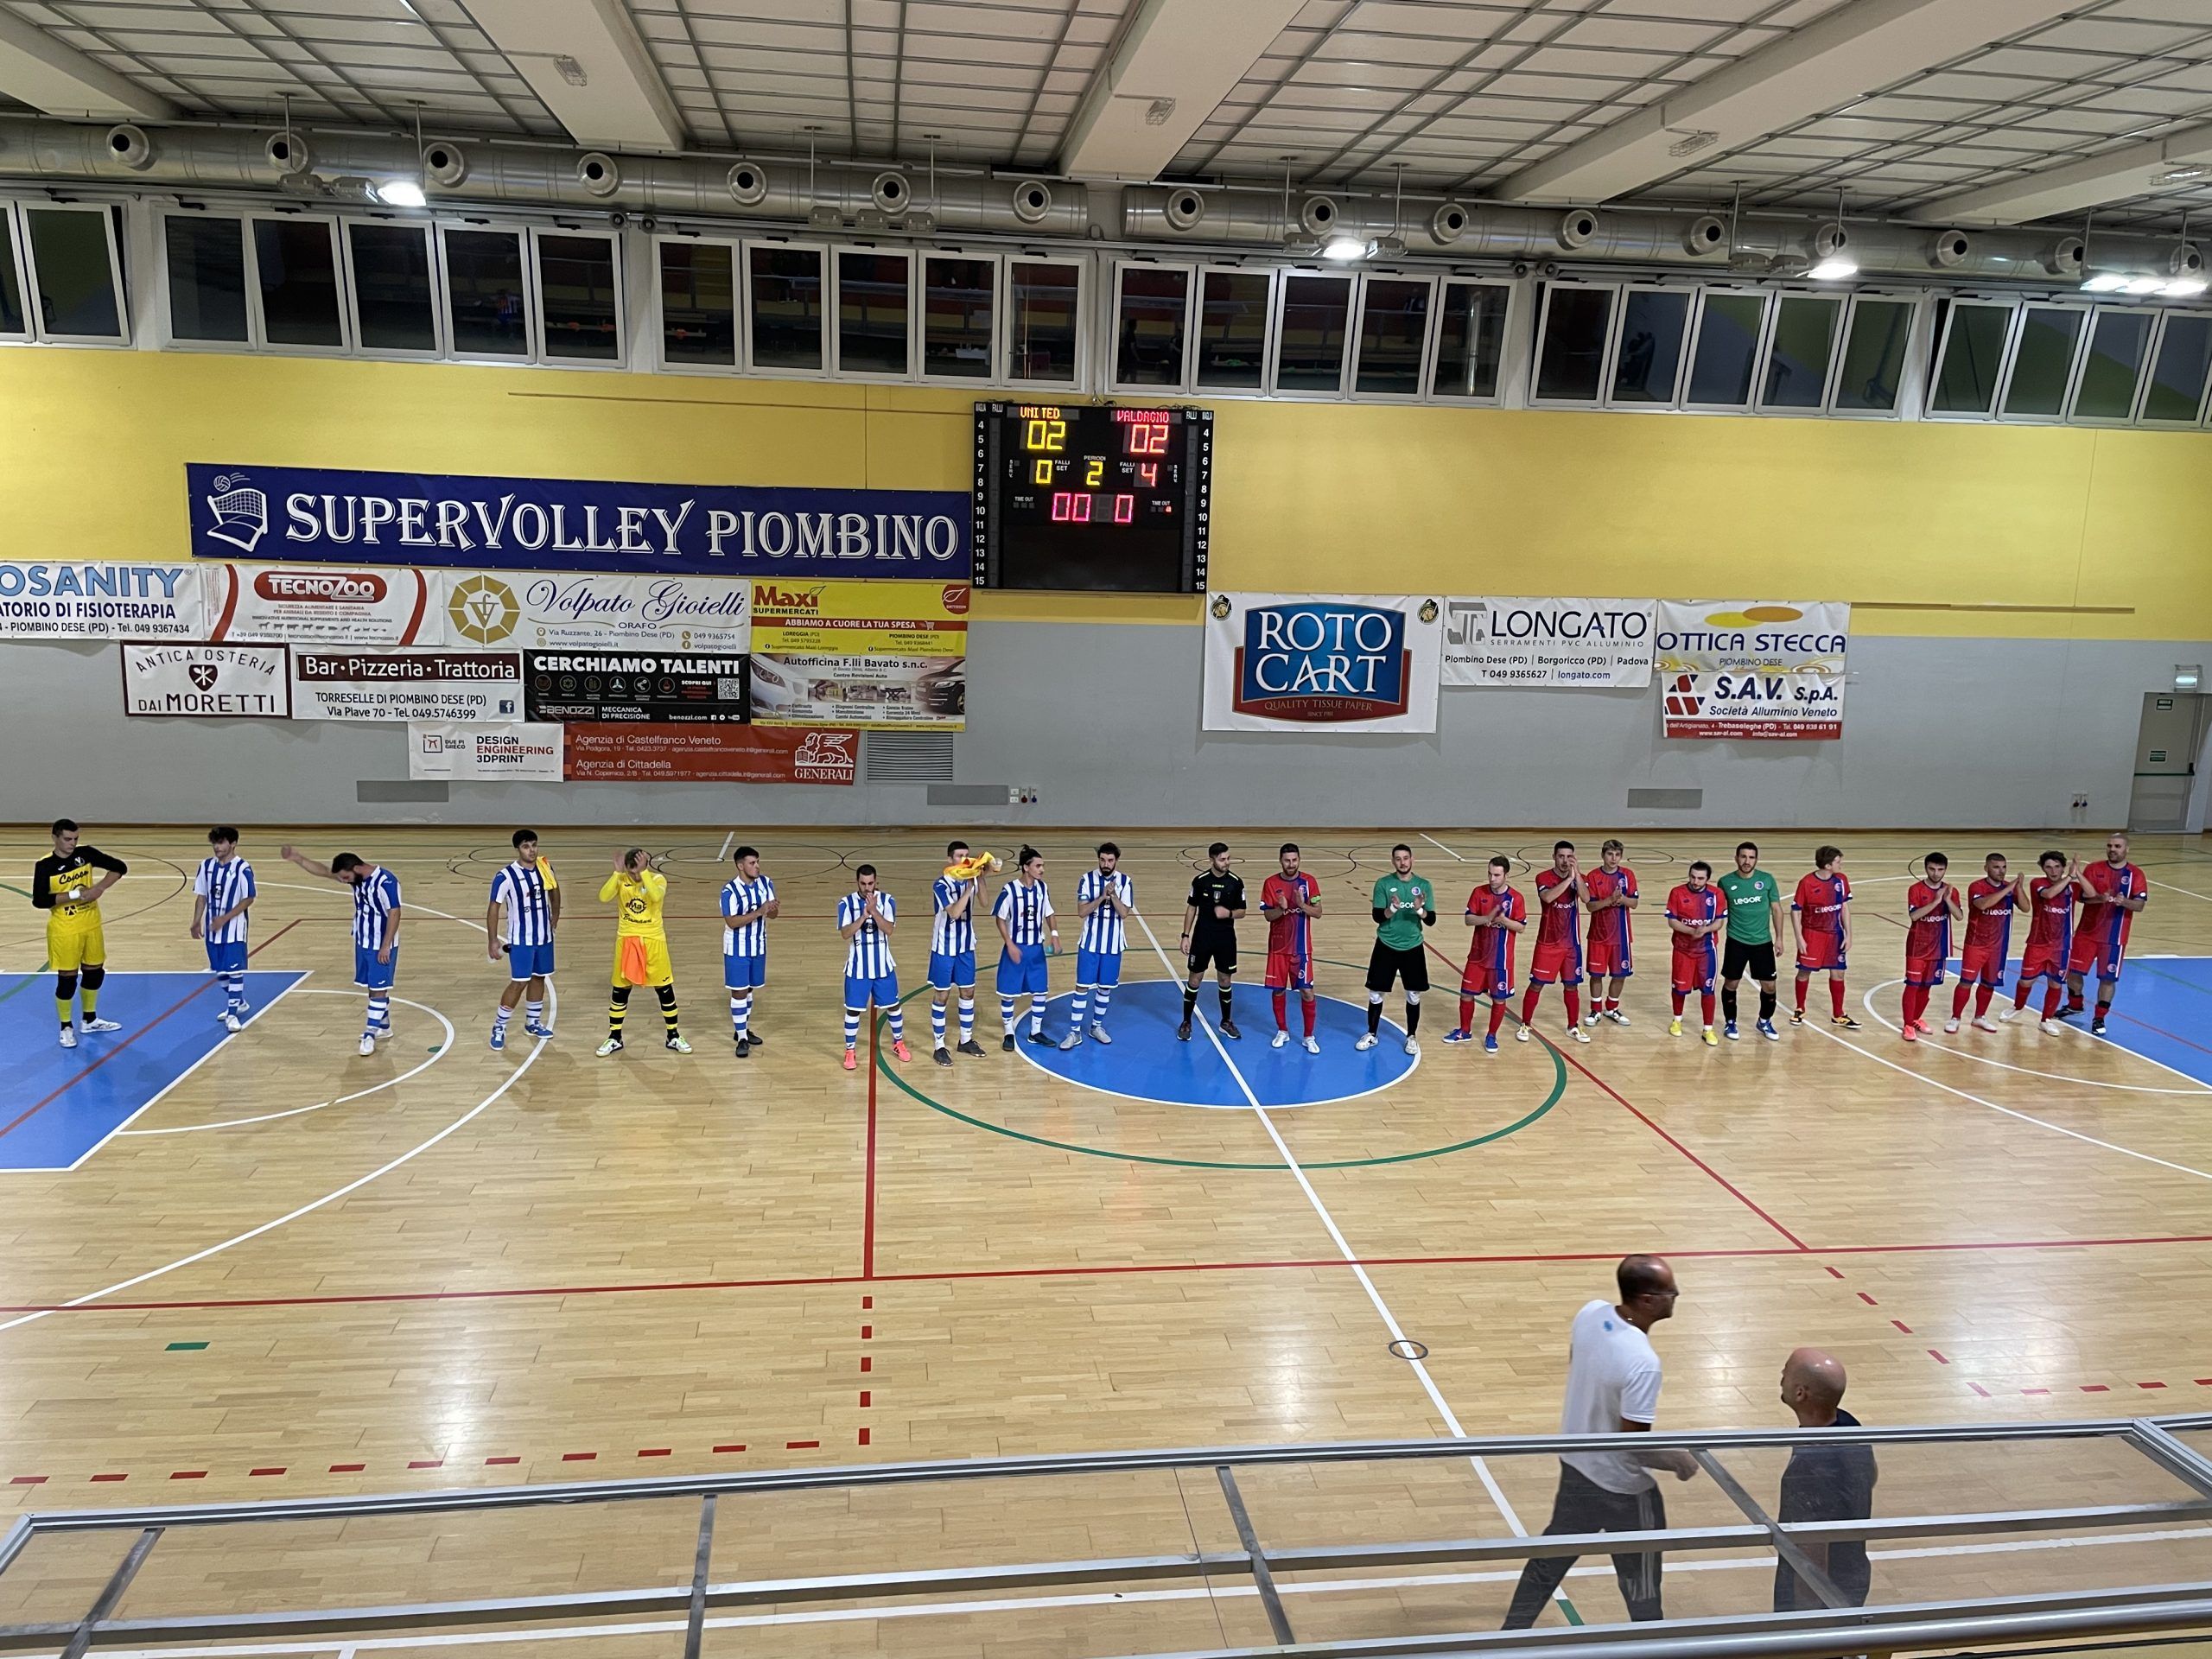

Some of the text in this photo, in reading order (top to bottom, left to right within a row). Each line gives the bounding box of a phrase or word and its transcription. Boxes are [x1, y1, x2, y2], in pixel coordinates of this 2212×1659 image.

[1116, 410, 1169, 423] VALDAGNO
[1027, 420, 1065, 449] 02
[1130, 424, 1168, 453] 02
[1203, 429, 1209, 437] 4
[978, 435, 984, 444] 5
[1203, 442, 1209, 451] 5
[978, 449, 984, 458] 6
[1035, 460, 1052, 484] 0
[1086, 461, 1103, 486] 2
[1141, 463, 1157, 486] 4
[1201, 486, 1207, 494] 8
[978, 493, 984, 501] 9
[1115, 494, 1134, 523] 0
[1201, 499, 1206, 508] 9
[975, 506, 985, 515] 10
[1198, 513, 1207, 522] 10
[285, 493, 958, 560] SUPERVOLLEY PIOMBINO
[1198, 527, 1206, 536] 11
[1198, 541, 1206, 550] 12
[1197, 555, 1206, 563] 13
[0, 565, 183, 598] OSANITY
[526, 578, 744, 621] Volpato Gioielli
[753, 585, 818, 607] Maxi
[56, 602, 71, 617] DI
[76, 602, 175, 619] FISIOTERAPIA
[753, 607, 818, 615] SUPERMERCATI
[10, 622, 189, 634] PIOMBINO DESE (PD) Tel. 049 9367434
[785, 619, 823, 627] ABBIAMO
[891, 620, 916, 629] SPESA
[1491, 610, 1647, 639] LONGATO
[1257, 611, 1392, 652] ROTO
[1656, 632, 1846, 652] OTTICA STECCA
[136, 649, 276, 676] ANTICA OSTERIA
[534, 657, 740, 674] CERCHIAMO TALENTI
[783, 657, 840, 667] Autofficina
[843, 658, 861, 667] F.lli
[864, 658, 899, 668] Bavato
[1445, 655, 1484, 664] Piombino
[1509, 656, 1528, 665] (PD)
[1537, 655, 1585, 665] Borgoricco
[1587, 656, 1606, 665] (PD)
[1617, 657, 1649, 665] Padova
[306, 657, 515, 678] Bar Pizzeria Trattoria
[1255, 653, 1387, 693] CART
[1490, 670, 1507, 678] 049
[1510, 670, 1547, 679] 9365627
[1557, 671, 1611, 681] longato.com
[1714, 676, 1838, 704] S.A.V. S.p.A.
[138, 694, 275, 712] DAI MORETTI
[315, 692, 486, 707] TORRESELLE DI PIOMBINO DESE (PD)
[1264, 698, 1373, 712] QUALITY TISSUE PAPER
[327, 707, 476, 719] Via Piave 70 Tel. 049.5746399
[546, 705, 594, 715] BENOZZI
[1709, 705, 1837, 717] Società Alluminio Veneto
[477, 736, 518, 745] DESIGN
[575, 734, 721, 745] Agenzia di Castelfranco Veneto
[477, 745, 554, 755] ENGINEERING
[477, 755, 524, 764] 3DPRINT
[576, 760, 671, 771] Agenzia di Cittadella
[794, 767, 853, 780] GENERALI
